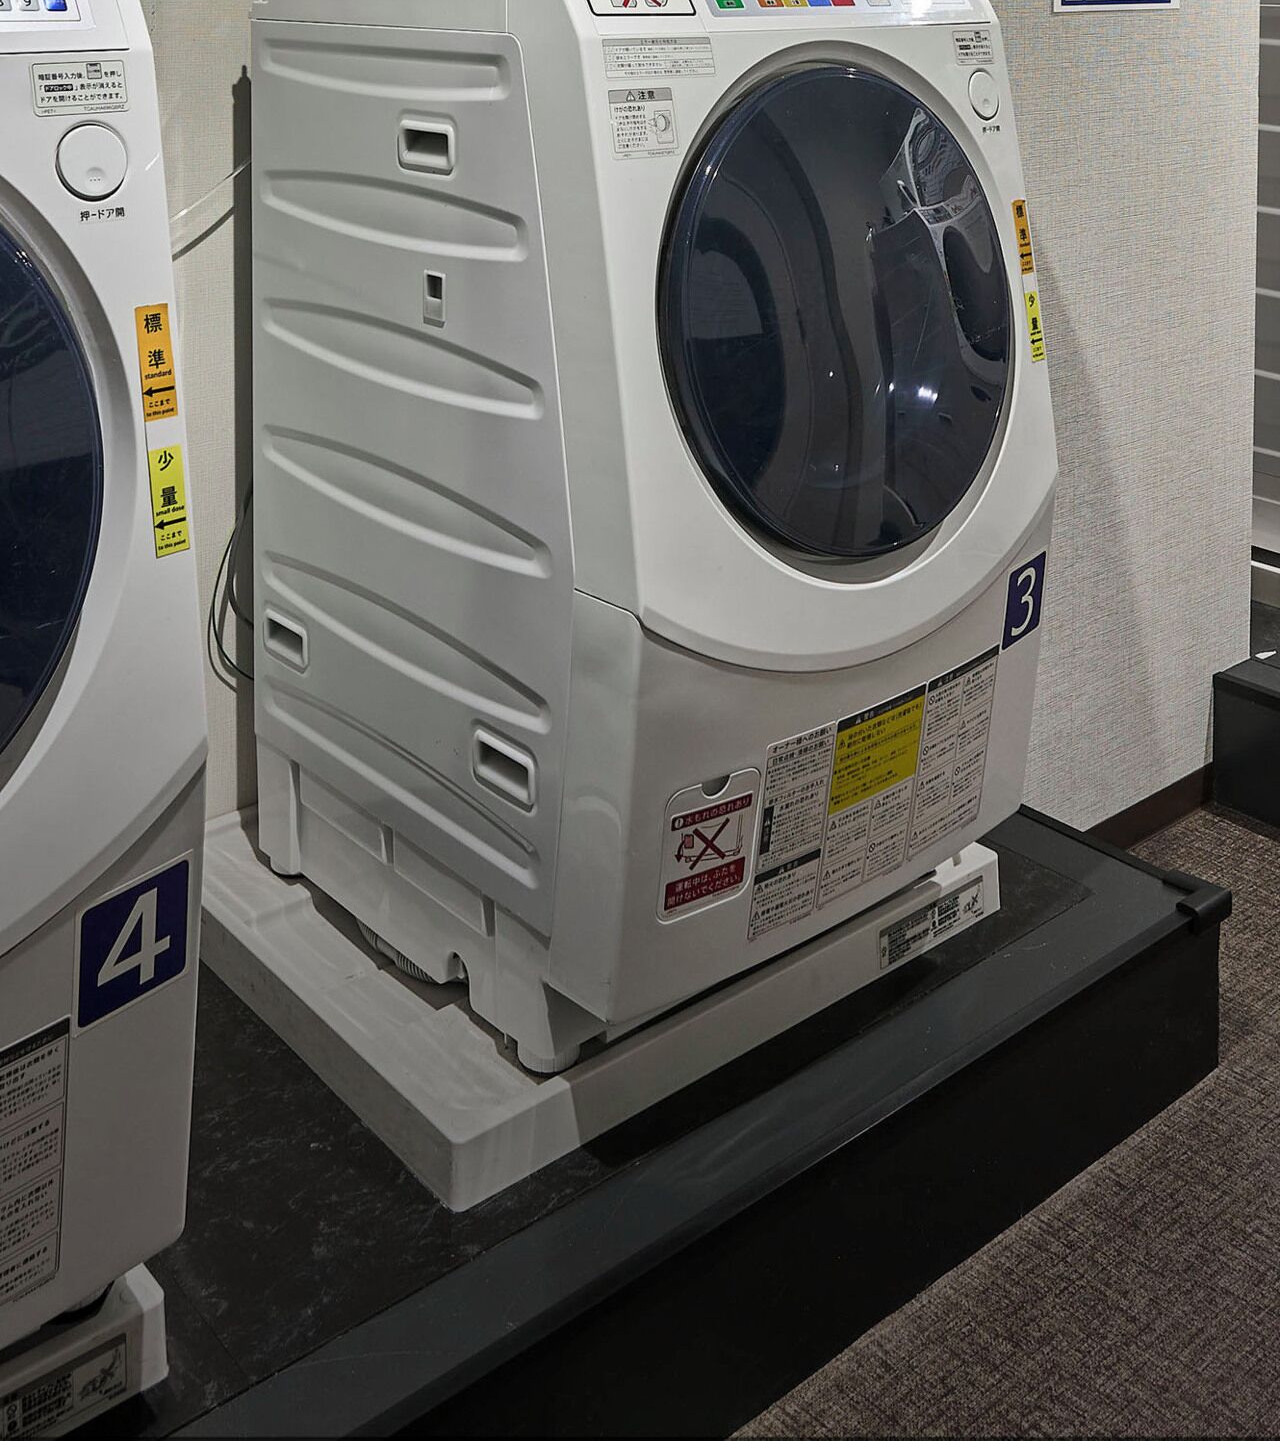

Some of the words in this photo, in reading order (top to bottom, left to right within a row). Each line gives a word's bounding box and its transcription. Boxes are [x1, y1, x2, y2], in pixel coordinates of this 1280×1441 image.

[637, 90, 656, 100] 注意
[144, 313, 166, 369] 標準
[144, 369, 172, 380] standard
[148, 398, 171, 408] ここまで
[157, 450, 178, 508] 少量
[160, 530, 183, 540] ここまで
[1010, 567, 1038, 637] 3
[685, 797, 751, 826] 水もれの恐れあり
[96, 887, 171, 987] 4
